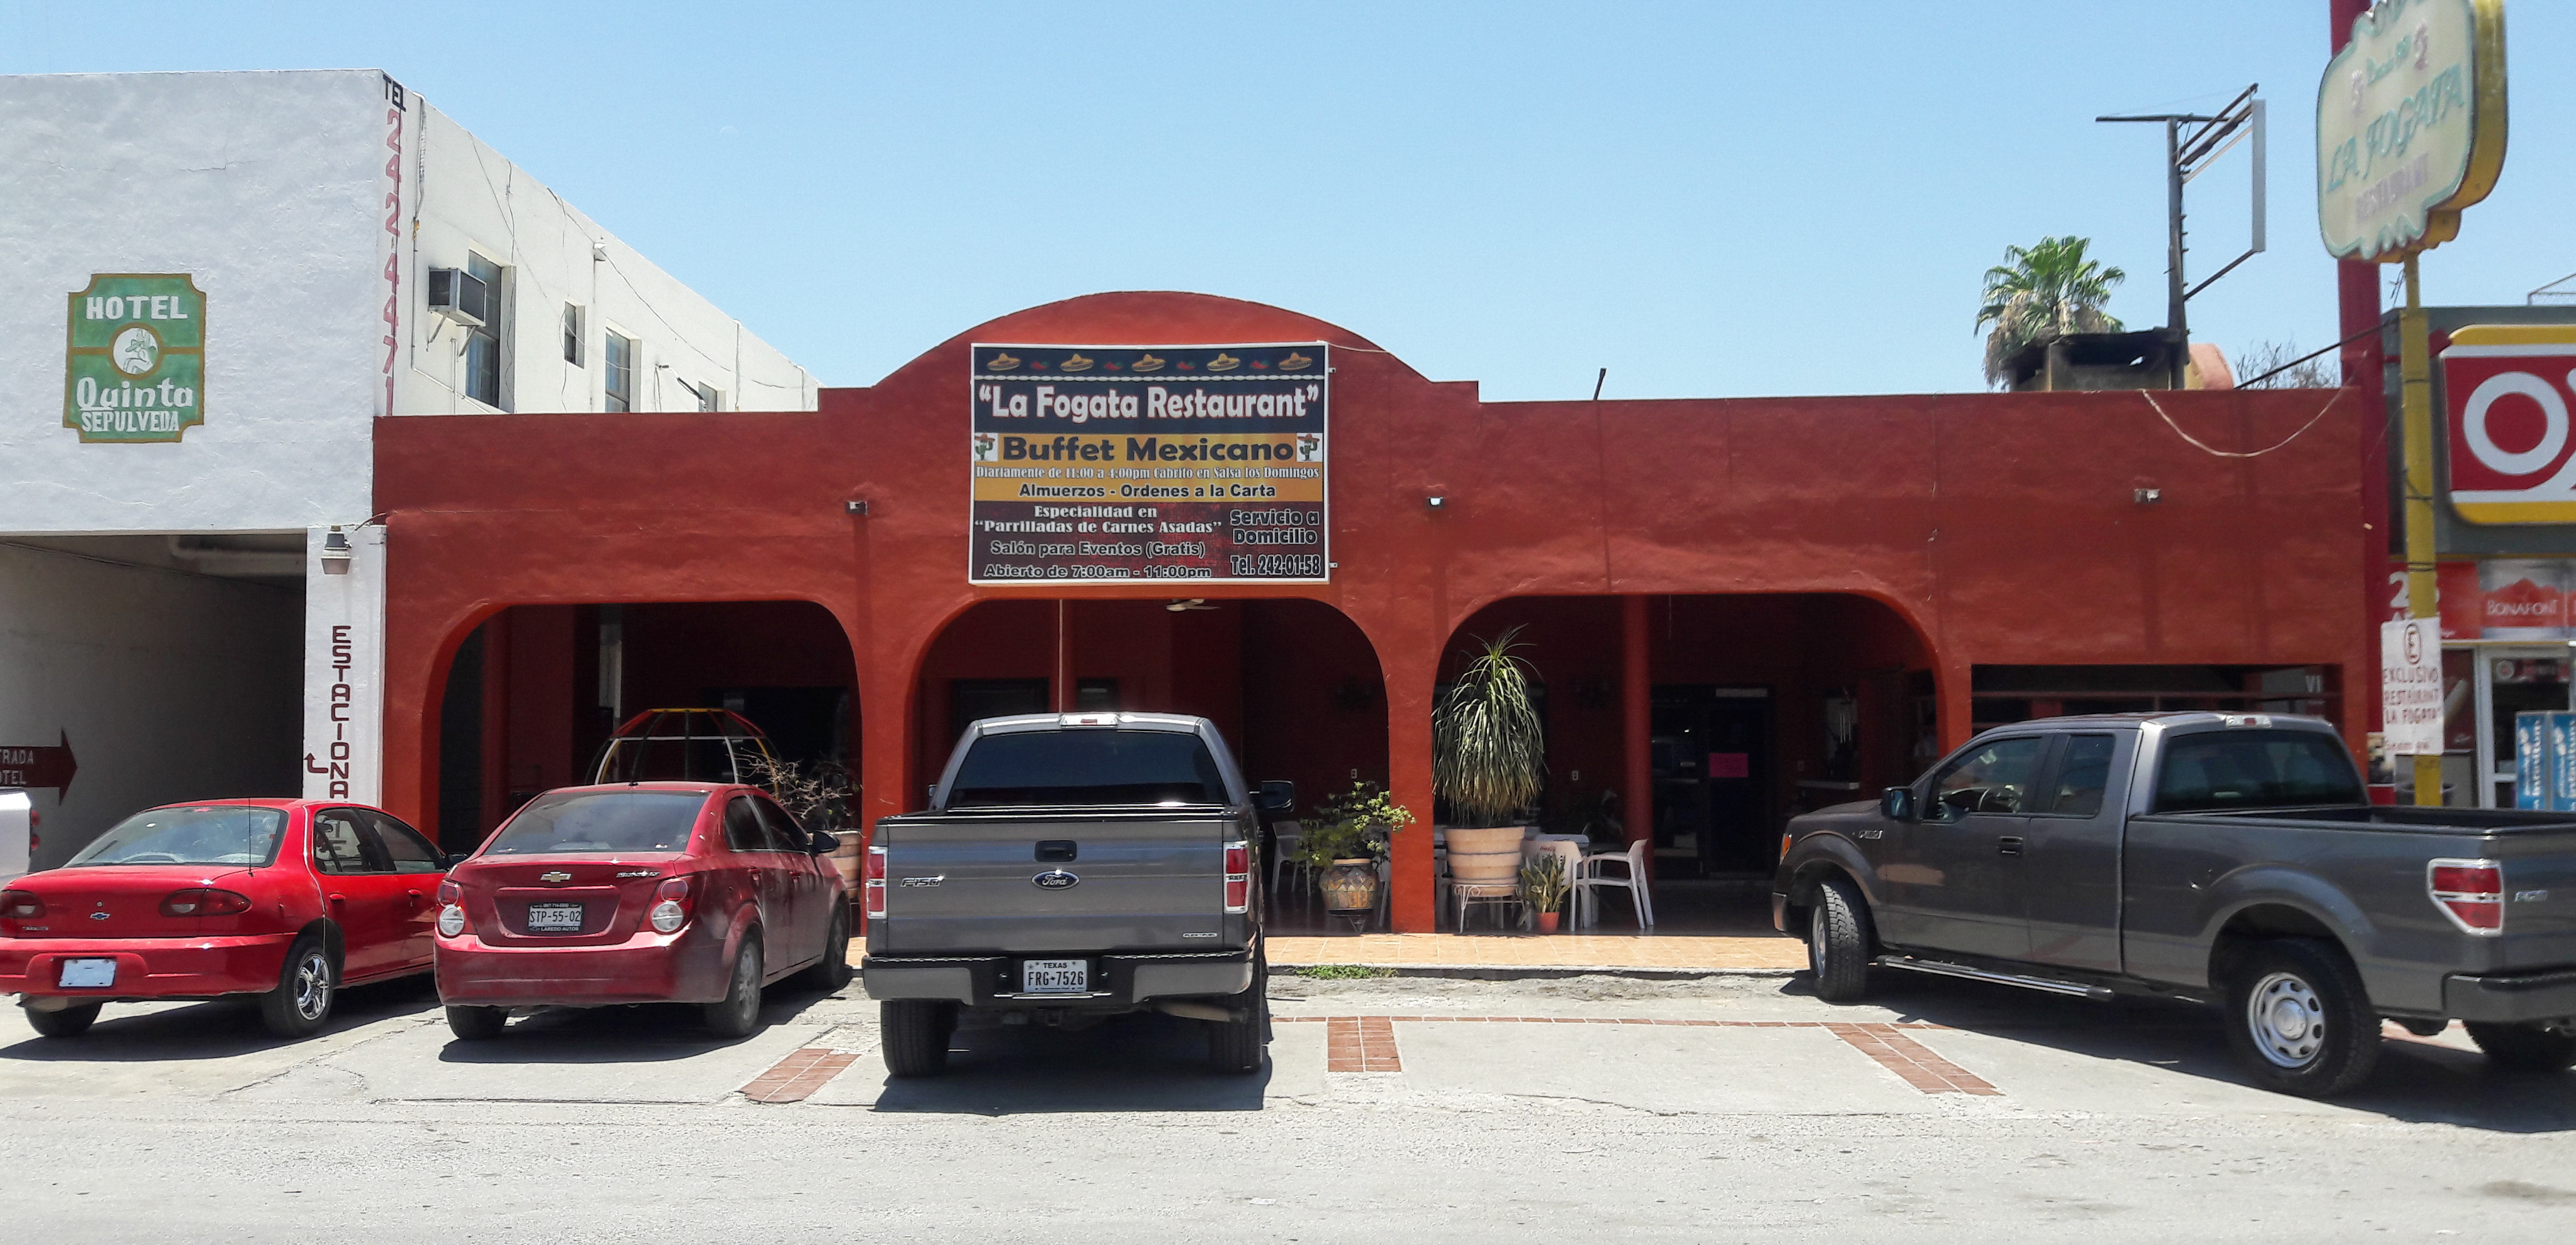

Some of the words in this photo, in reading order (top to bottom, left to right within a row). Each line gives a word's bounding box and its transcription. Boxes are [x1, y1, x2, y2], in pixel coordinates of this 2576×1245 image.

[85, 295, 189, 320] HOTEL
[76, 377, 193, 411] Quinta
[1036, 385, 1139, 424] Fogata
[80, 410, 180, 432] SEPULVEDA
[1003, 435, 1115, 462] Buffet
[1126, 437, 1294, 462] Mexicano
[976, 466, 1045, 479] Diariamente
[1048, 466, 1062, 479] de
[1066, 467, 1094, 479] 11:00
[1097, 469, 1105, 479] a
[1108, 467, 1151, 481] 4:00pm
[1153, 466, 1193, 479] Cabrito
[1196, 469, 1211, 479] en
[1213, 467, 1242, 479] Salsa
[1245, 466, 1261, 479] los
[1263, 466, 1320, 480] Domingos
[1019, 483, 1105, 498] Almuerzos
[1120, 483, 1190, 498] Ordenes
[1194, 487, 1205, 498] a
[1210, 484, 1225, 498] la
[1230, 483, 1276, 498] Carta
[1034, 505, 1133, 519] Especialidad
[1137, 507, 1158, 518] en
[1230, 508, 1302, 526] Servicio
[1306, 510, 1320, 526] a
[1077, 520, 1097, 533] de
[1102, 520, 1154, 533] Carnes
[1232, 528, 1318, 545] Domicilio
[990, 540, 1035, 555] Salón
[1038, 543, 1076, 558] para
[1078, 541, 1142, 556] Eventos
[1145, 541, 1206, 558] (Gratis)
[983, 563, 1044, 578] Abierto
[1046, 565, 1068, 578] de
[1071, 565, 1131, 578] 7:00am
[1143, 565, 1212, 579] 11:00pm
[1230, 555, 1255, 575] Tel.
[1257, 554, 1322, 575] 242-01-58
[2487, 599, 2558, 615] BONAFONT
[1042, 874, 1068, 885] Ford
[530, 911, 581, 922] STP-55-02
